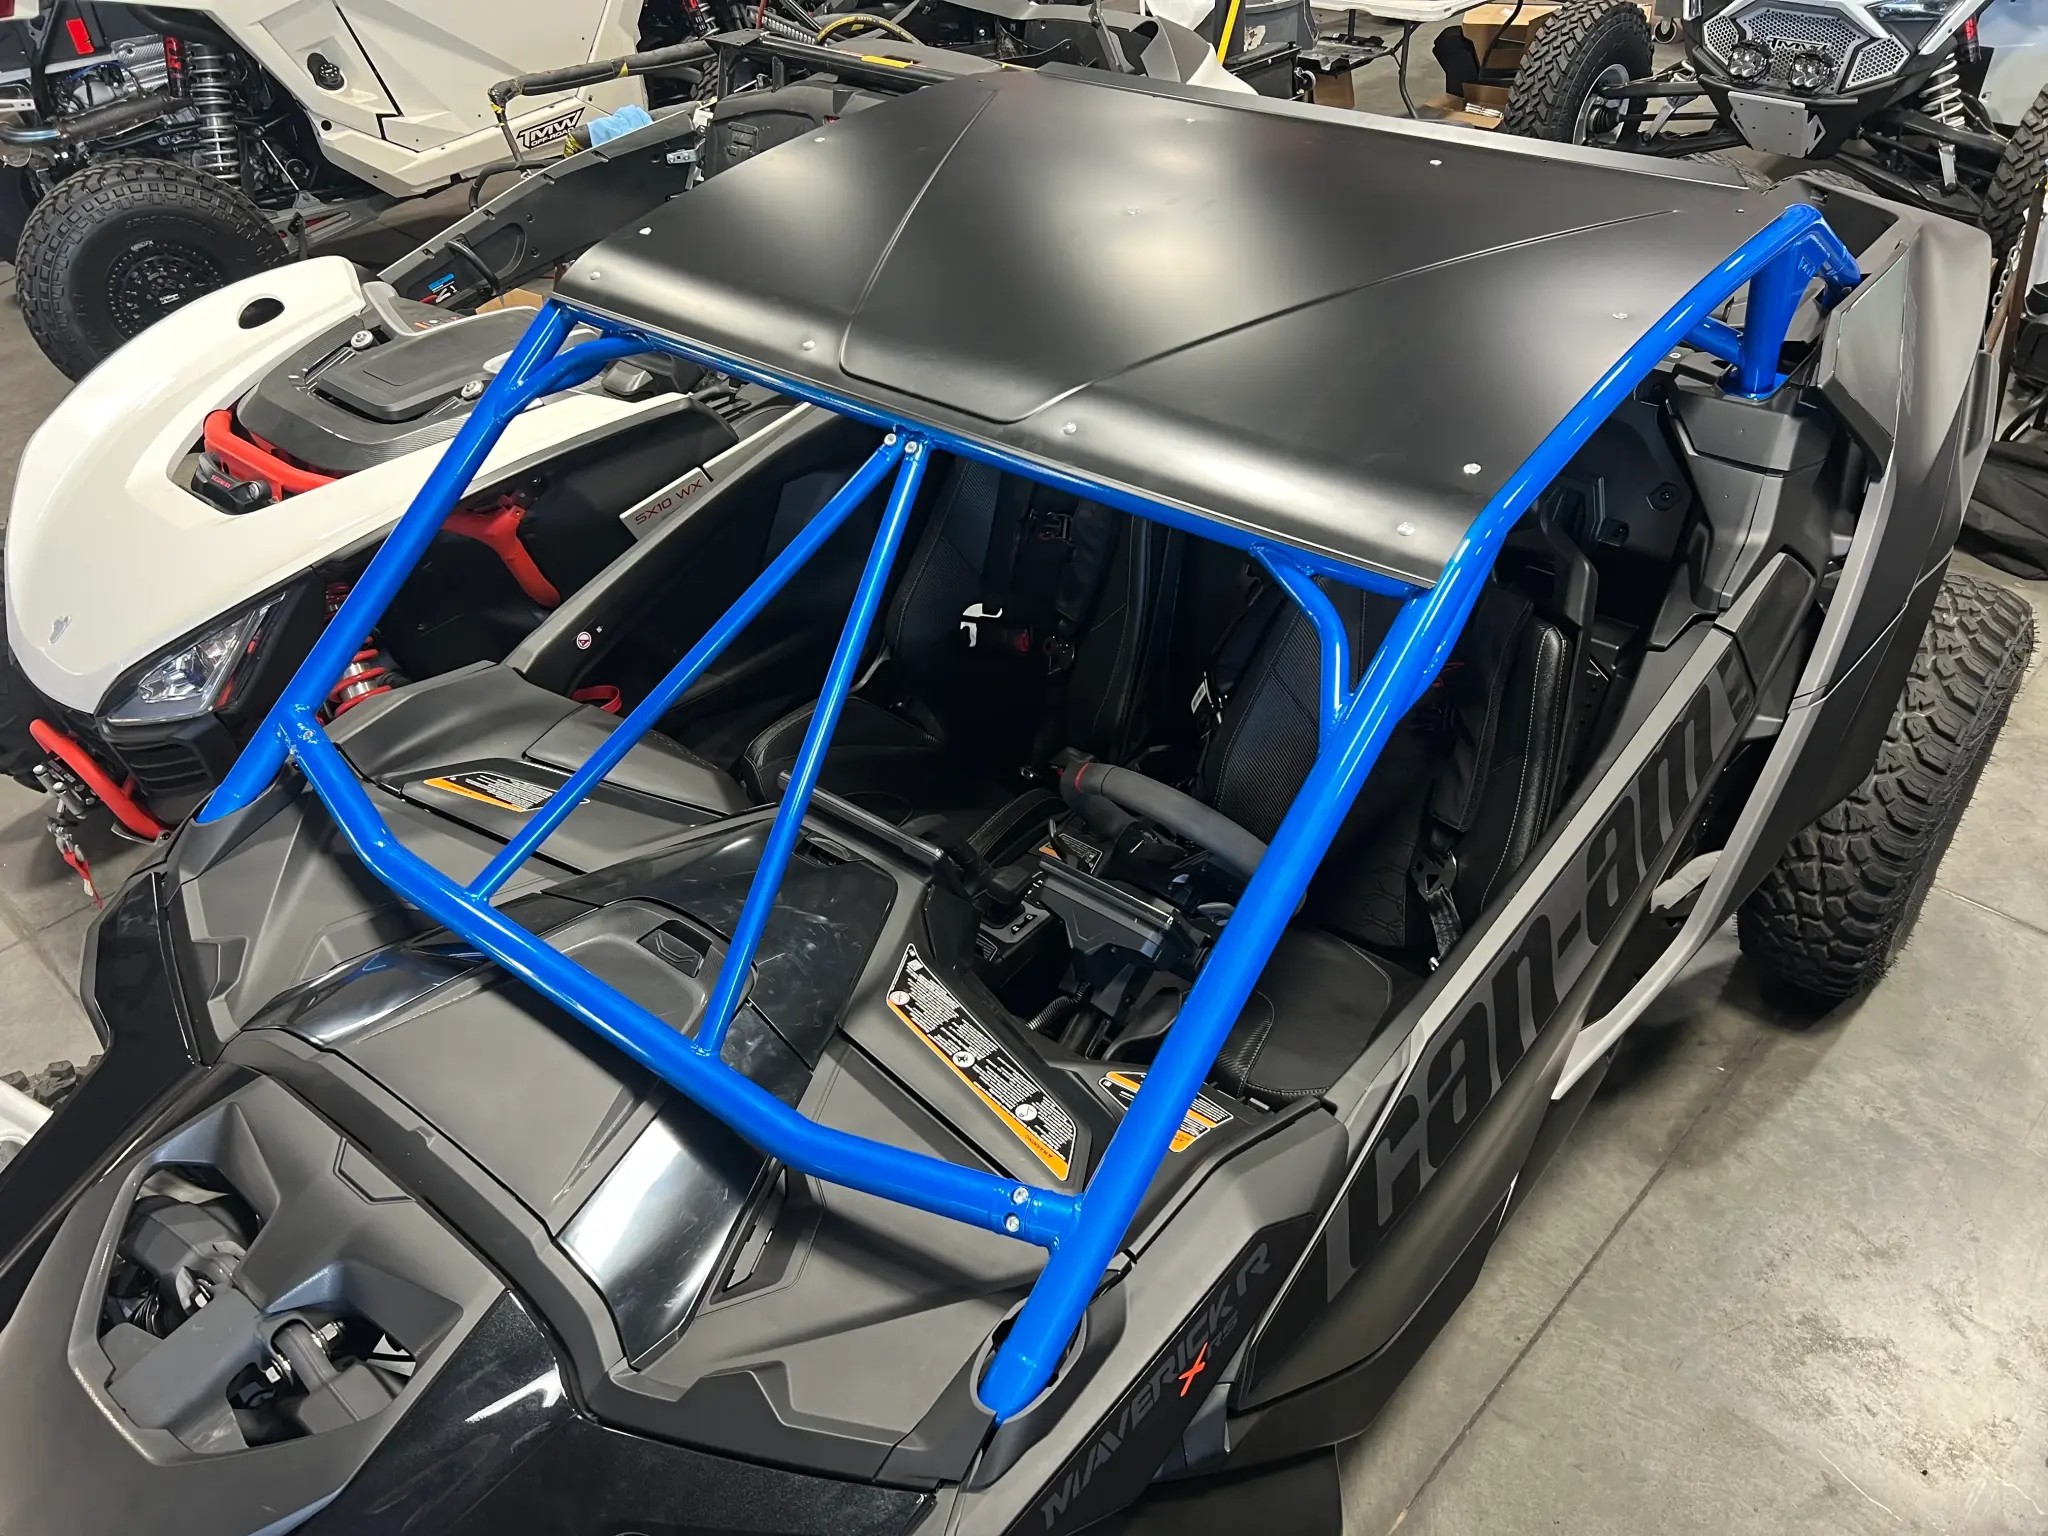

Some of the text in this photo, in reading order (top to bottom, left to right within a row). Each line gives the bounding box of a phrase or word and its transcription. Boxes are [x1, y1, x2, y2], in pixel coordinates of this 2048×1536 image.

[519, 109, 583, 147] TMW
[635, 478, 704, 526] SX10 WX
[1040, 1242, 1271, 1530] MAVERICK R
